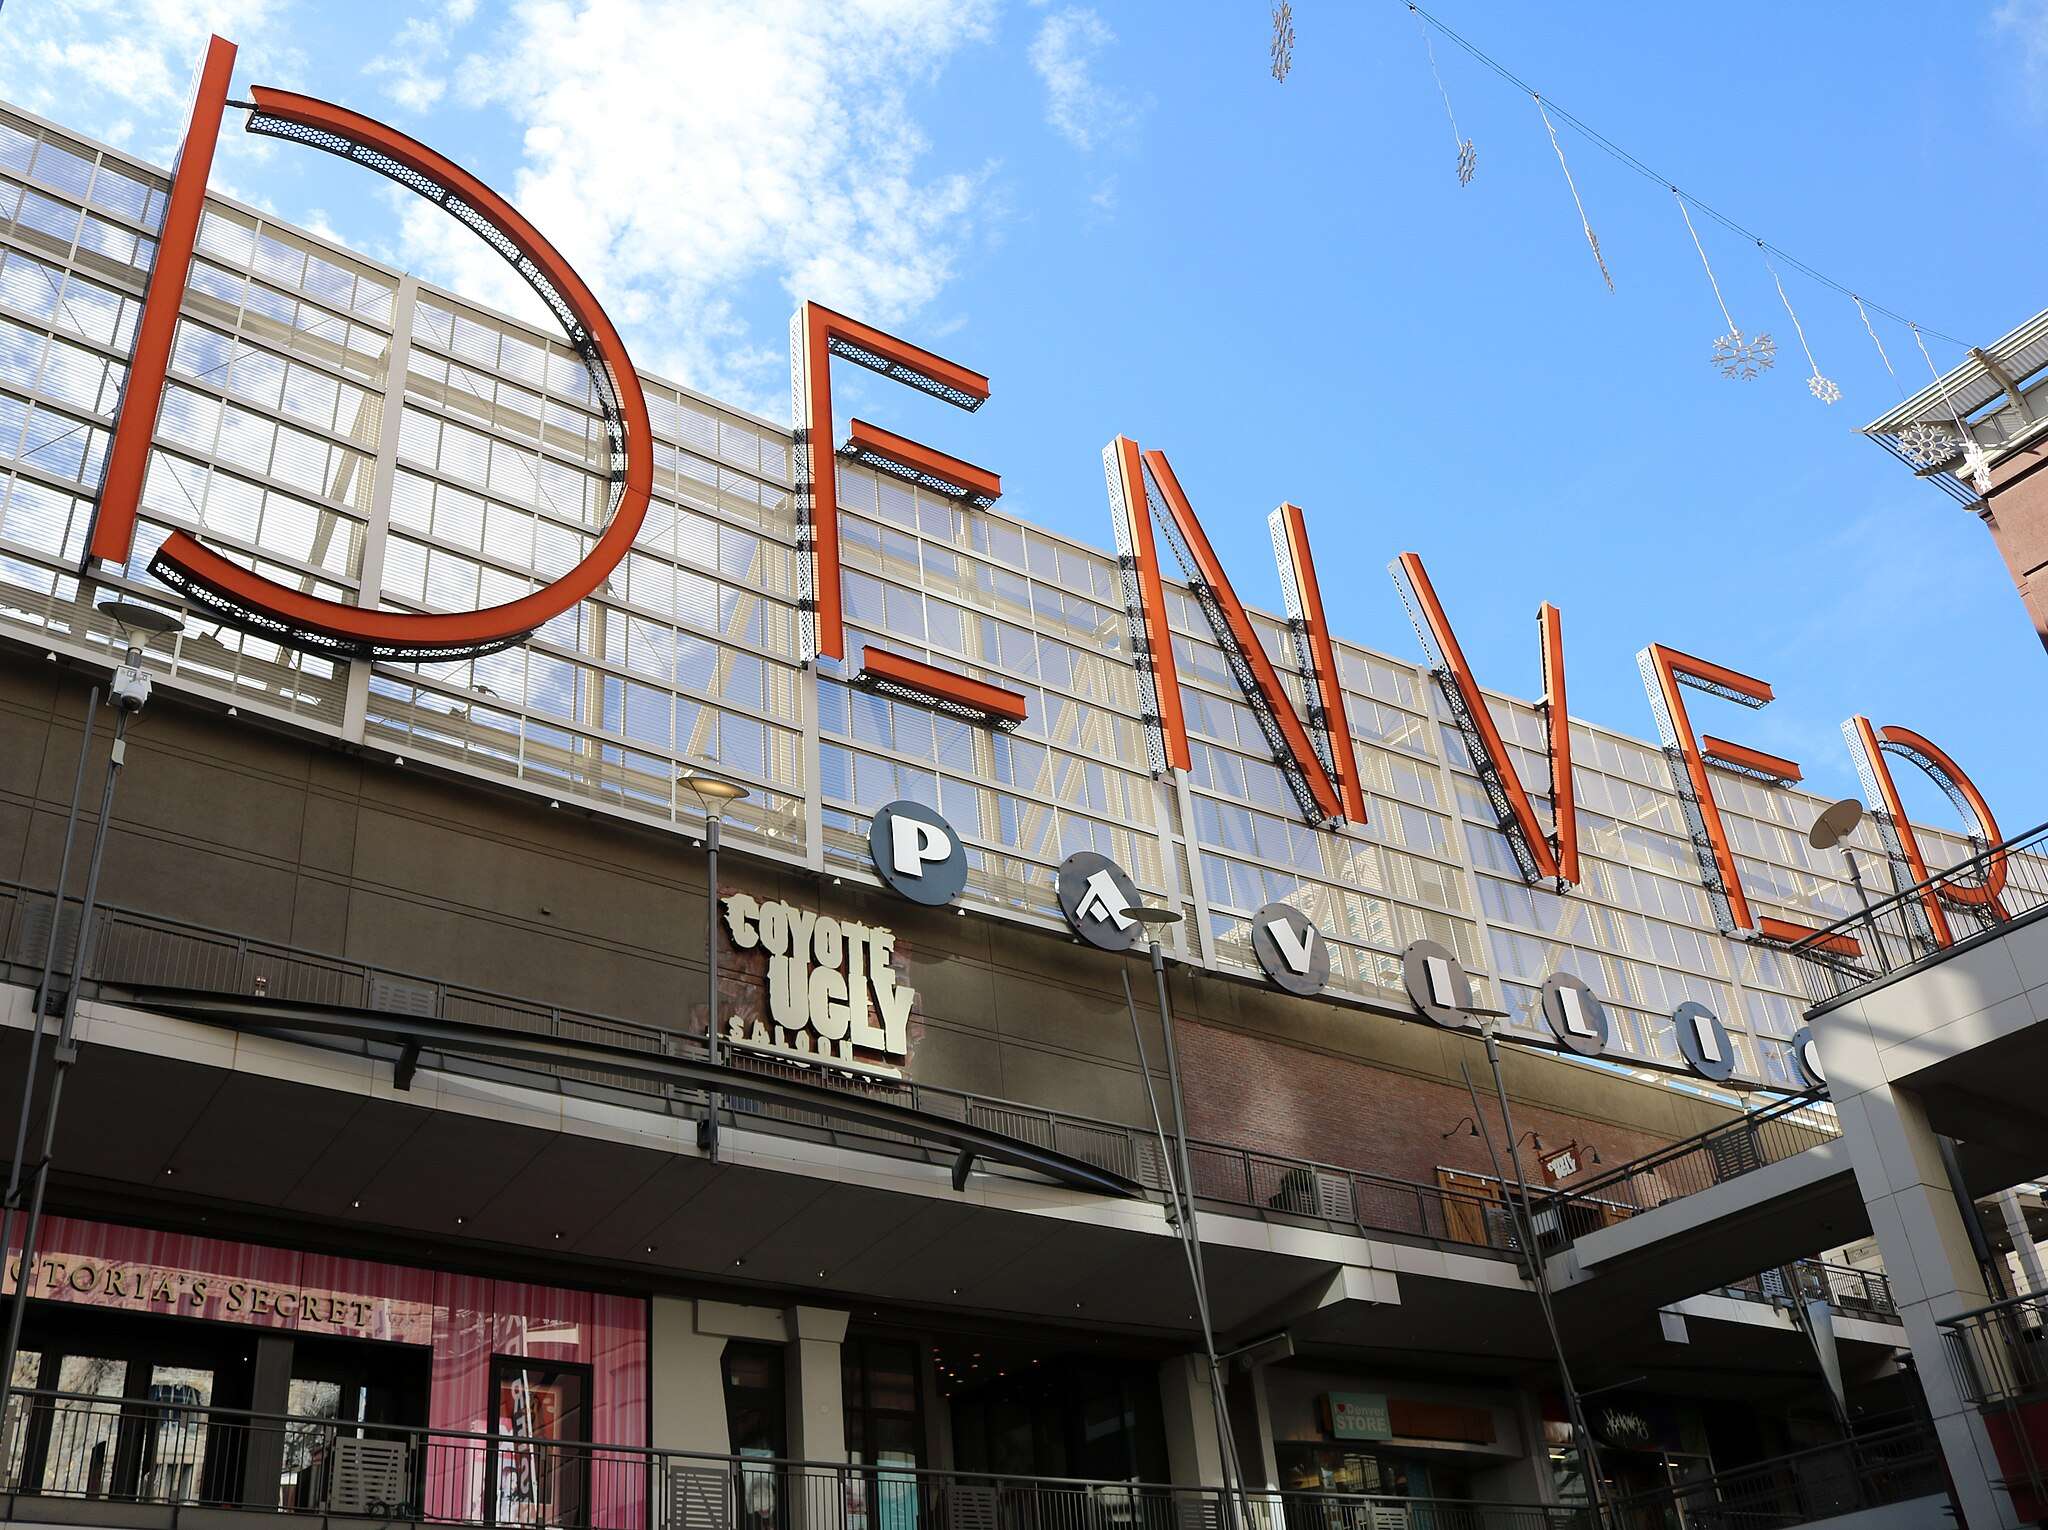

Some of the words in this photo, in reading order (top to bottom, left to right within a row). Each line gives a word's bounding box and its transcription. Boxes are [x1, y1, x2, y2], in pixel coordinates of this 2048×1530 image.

[90, 34, 2010, 957] DENVER
[721, 893, 896, 984] COYOTE
[891, 814, 1825, 1082] PAVILI
[728, 1014, 853, 1064] SALOON
[768, 954, 915, 1055] UGLY
[226, 1283, 372, 1327] SECRET
[1335, 1414, 1387, 1433] STORE
[1345, 1403, 1385, 1417] Denver
